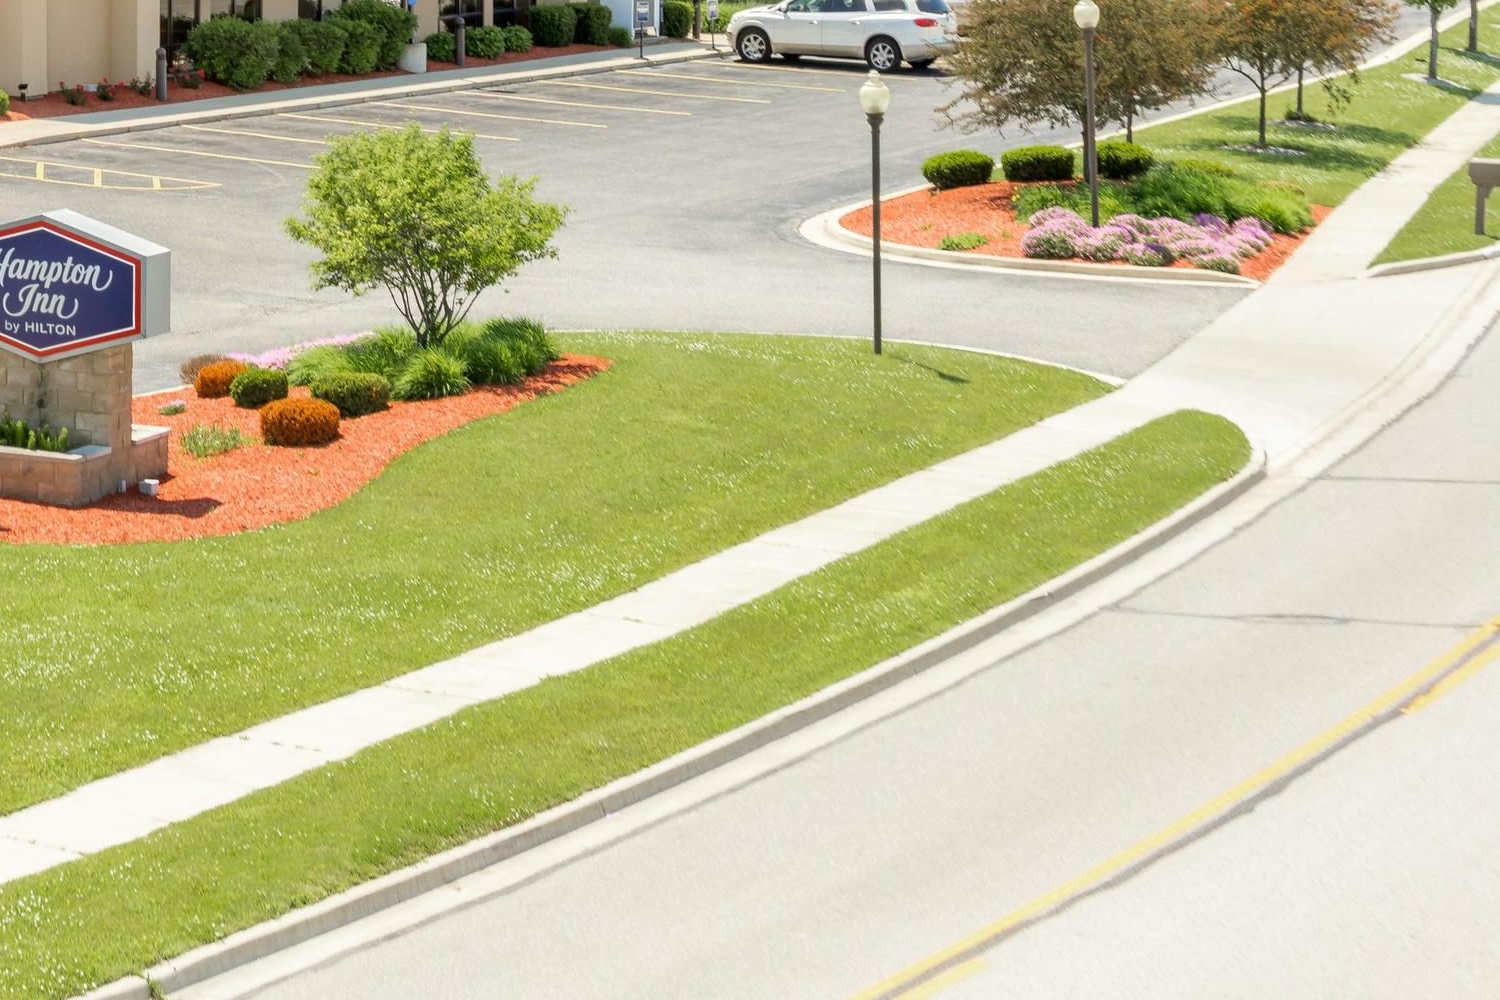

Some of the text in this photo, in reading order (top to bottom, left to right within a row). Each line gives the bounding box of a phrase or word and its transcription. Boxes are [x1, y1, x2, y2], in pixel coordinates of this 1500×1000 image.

[2, 287, 79, 320] Inn
[4, 320, 76, 336] by HILTON
